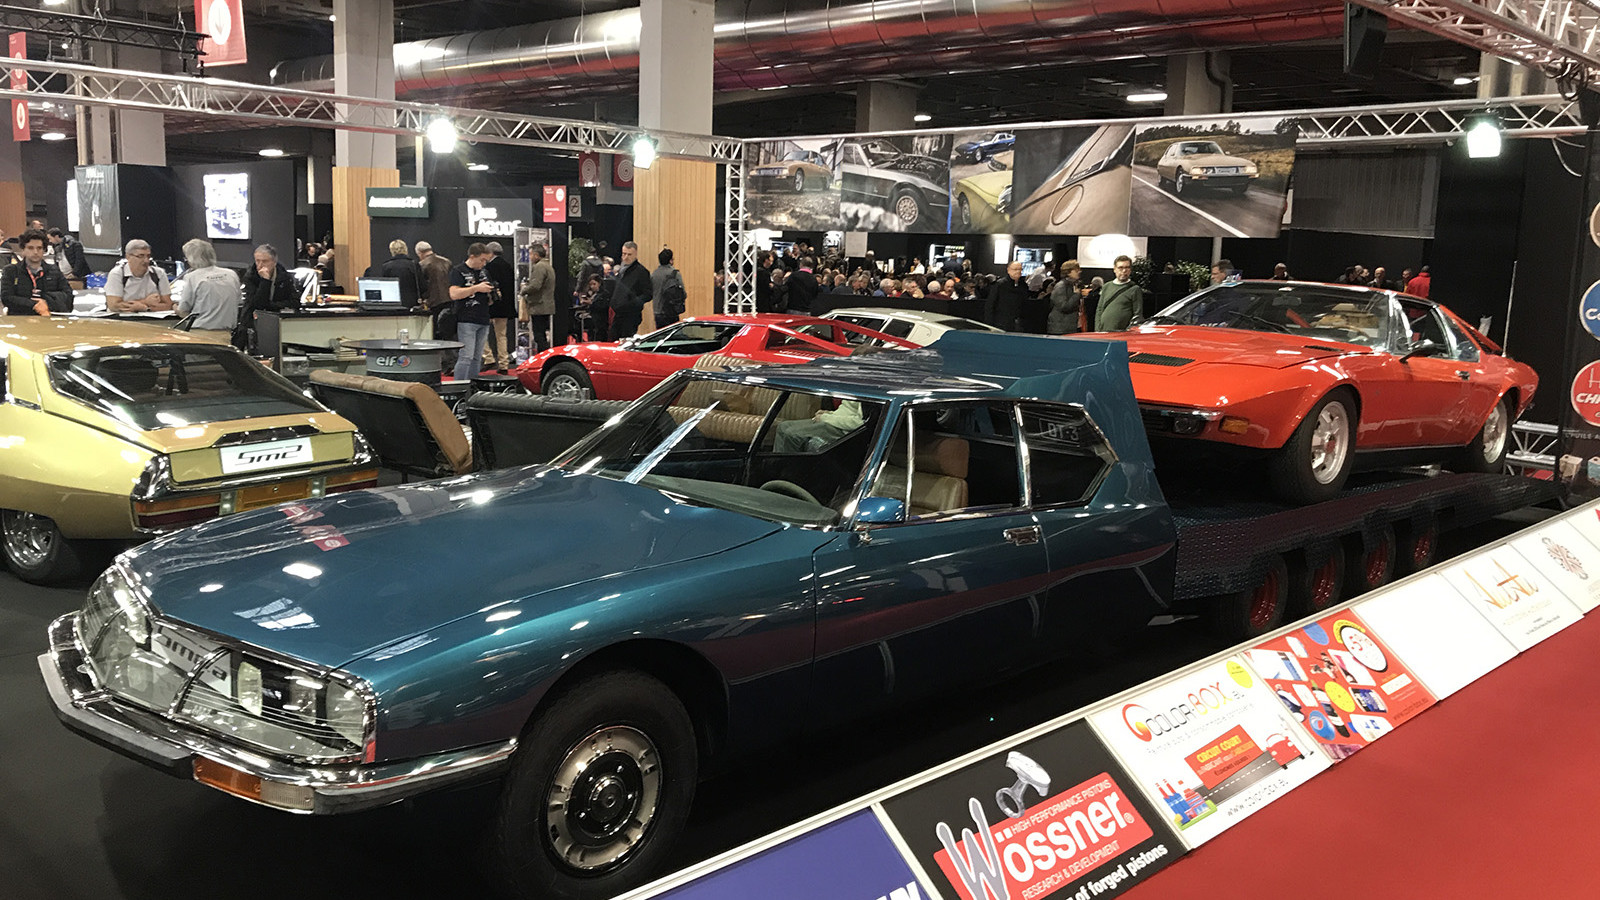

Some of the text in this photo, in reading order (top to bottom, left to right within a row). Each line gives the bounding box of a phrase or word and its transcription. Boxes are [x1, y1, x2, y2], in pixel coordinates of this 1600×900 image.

[376, 355, 398, 366] elf
[1010, 779, 1112, 835] HIGH PERFORMANCE PISTONS
[1021, 840, 1120, 900] RESEARCH & DEVELOPMENT
[1087, 864, 1129, 896] forged
[1125, 844, 1169, 877] pistons
